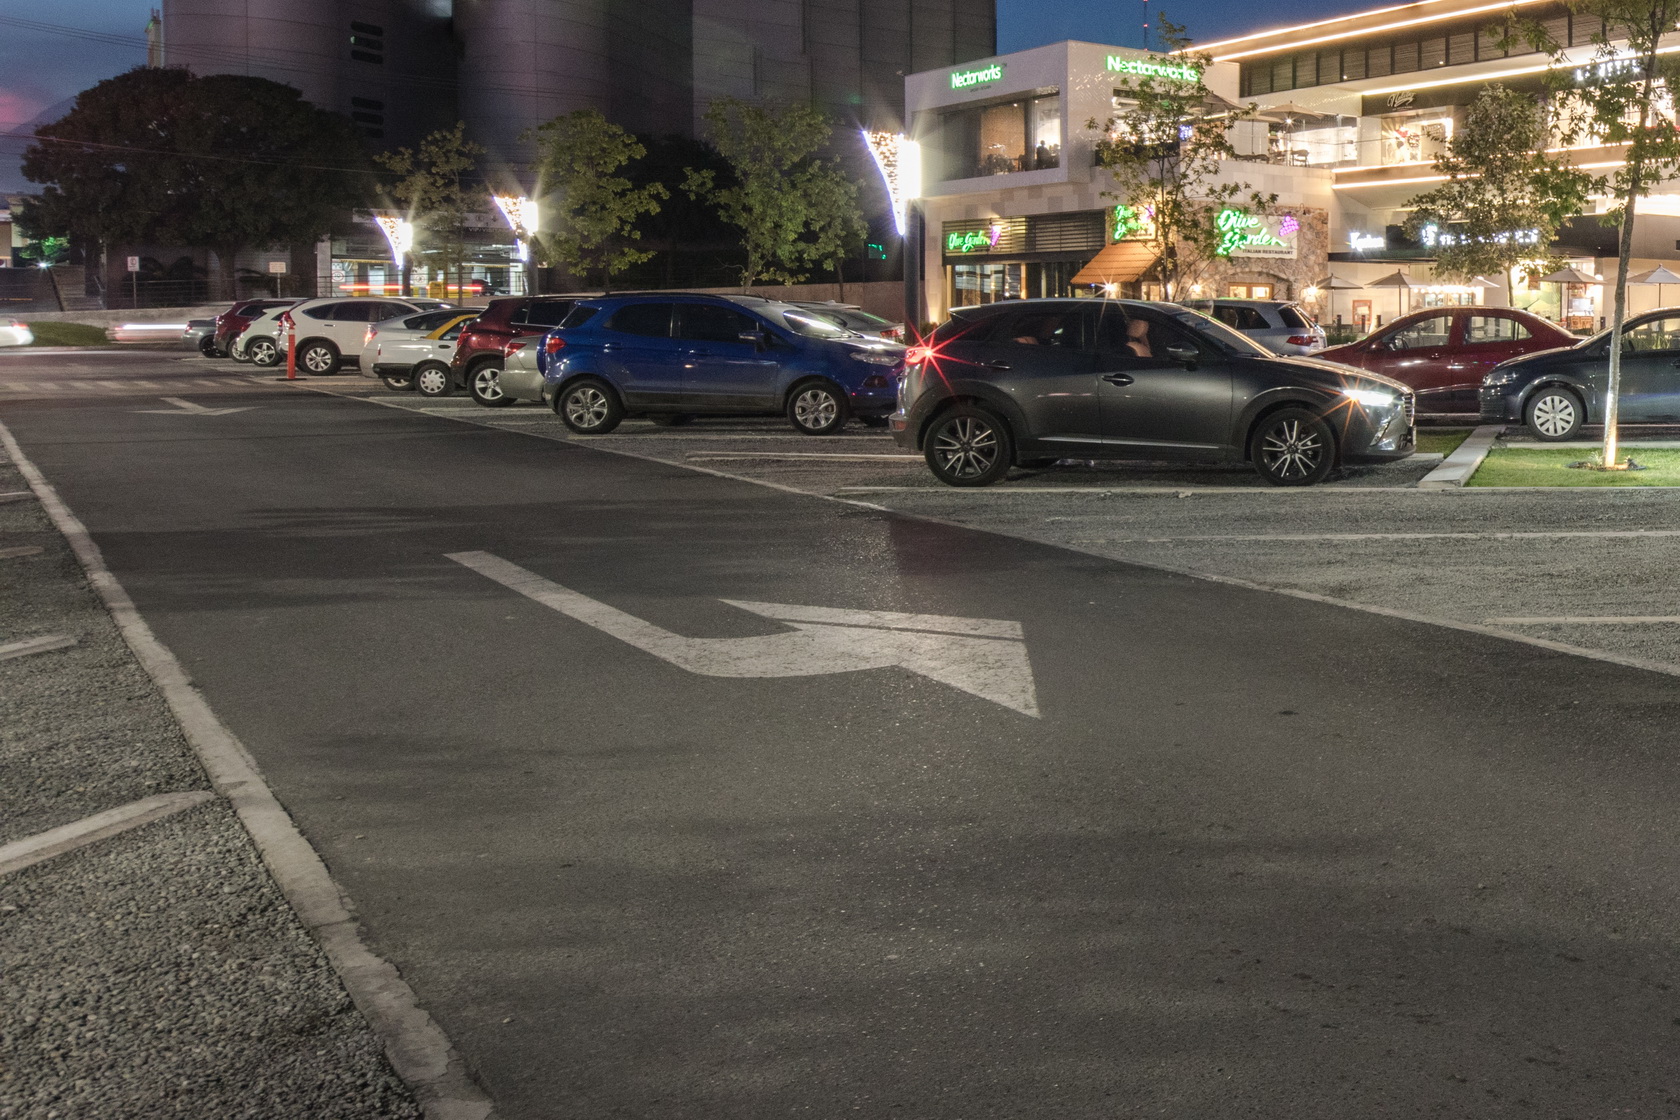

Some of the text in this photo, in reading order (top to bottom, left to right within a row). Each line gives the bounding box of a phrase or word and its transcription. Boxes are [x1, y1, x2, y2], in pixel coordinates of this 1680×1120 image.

[951, 64, 1001, 89] Nectarworks
[1107, 55, 1199, 82] Nectarworks
[1218, 209, 1261, 231] Olive
